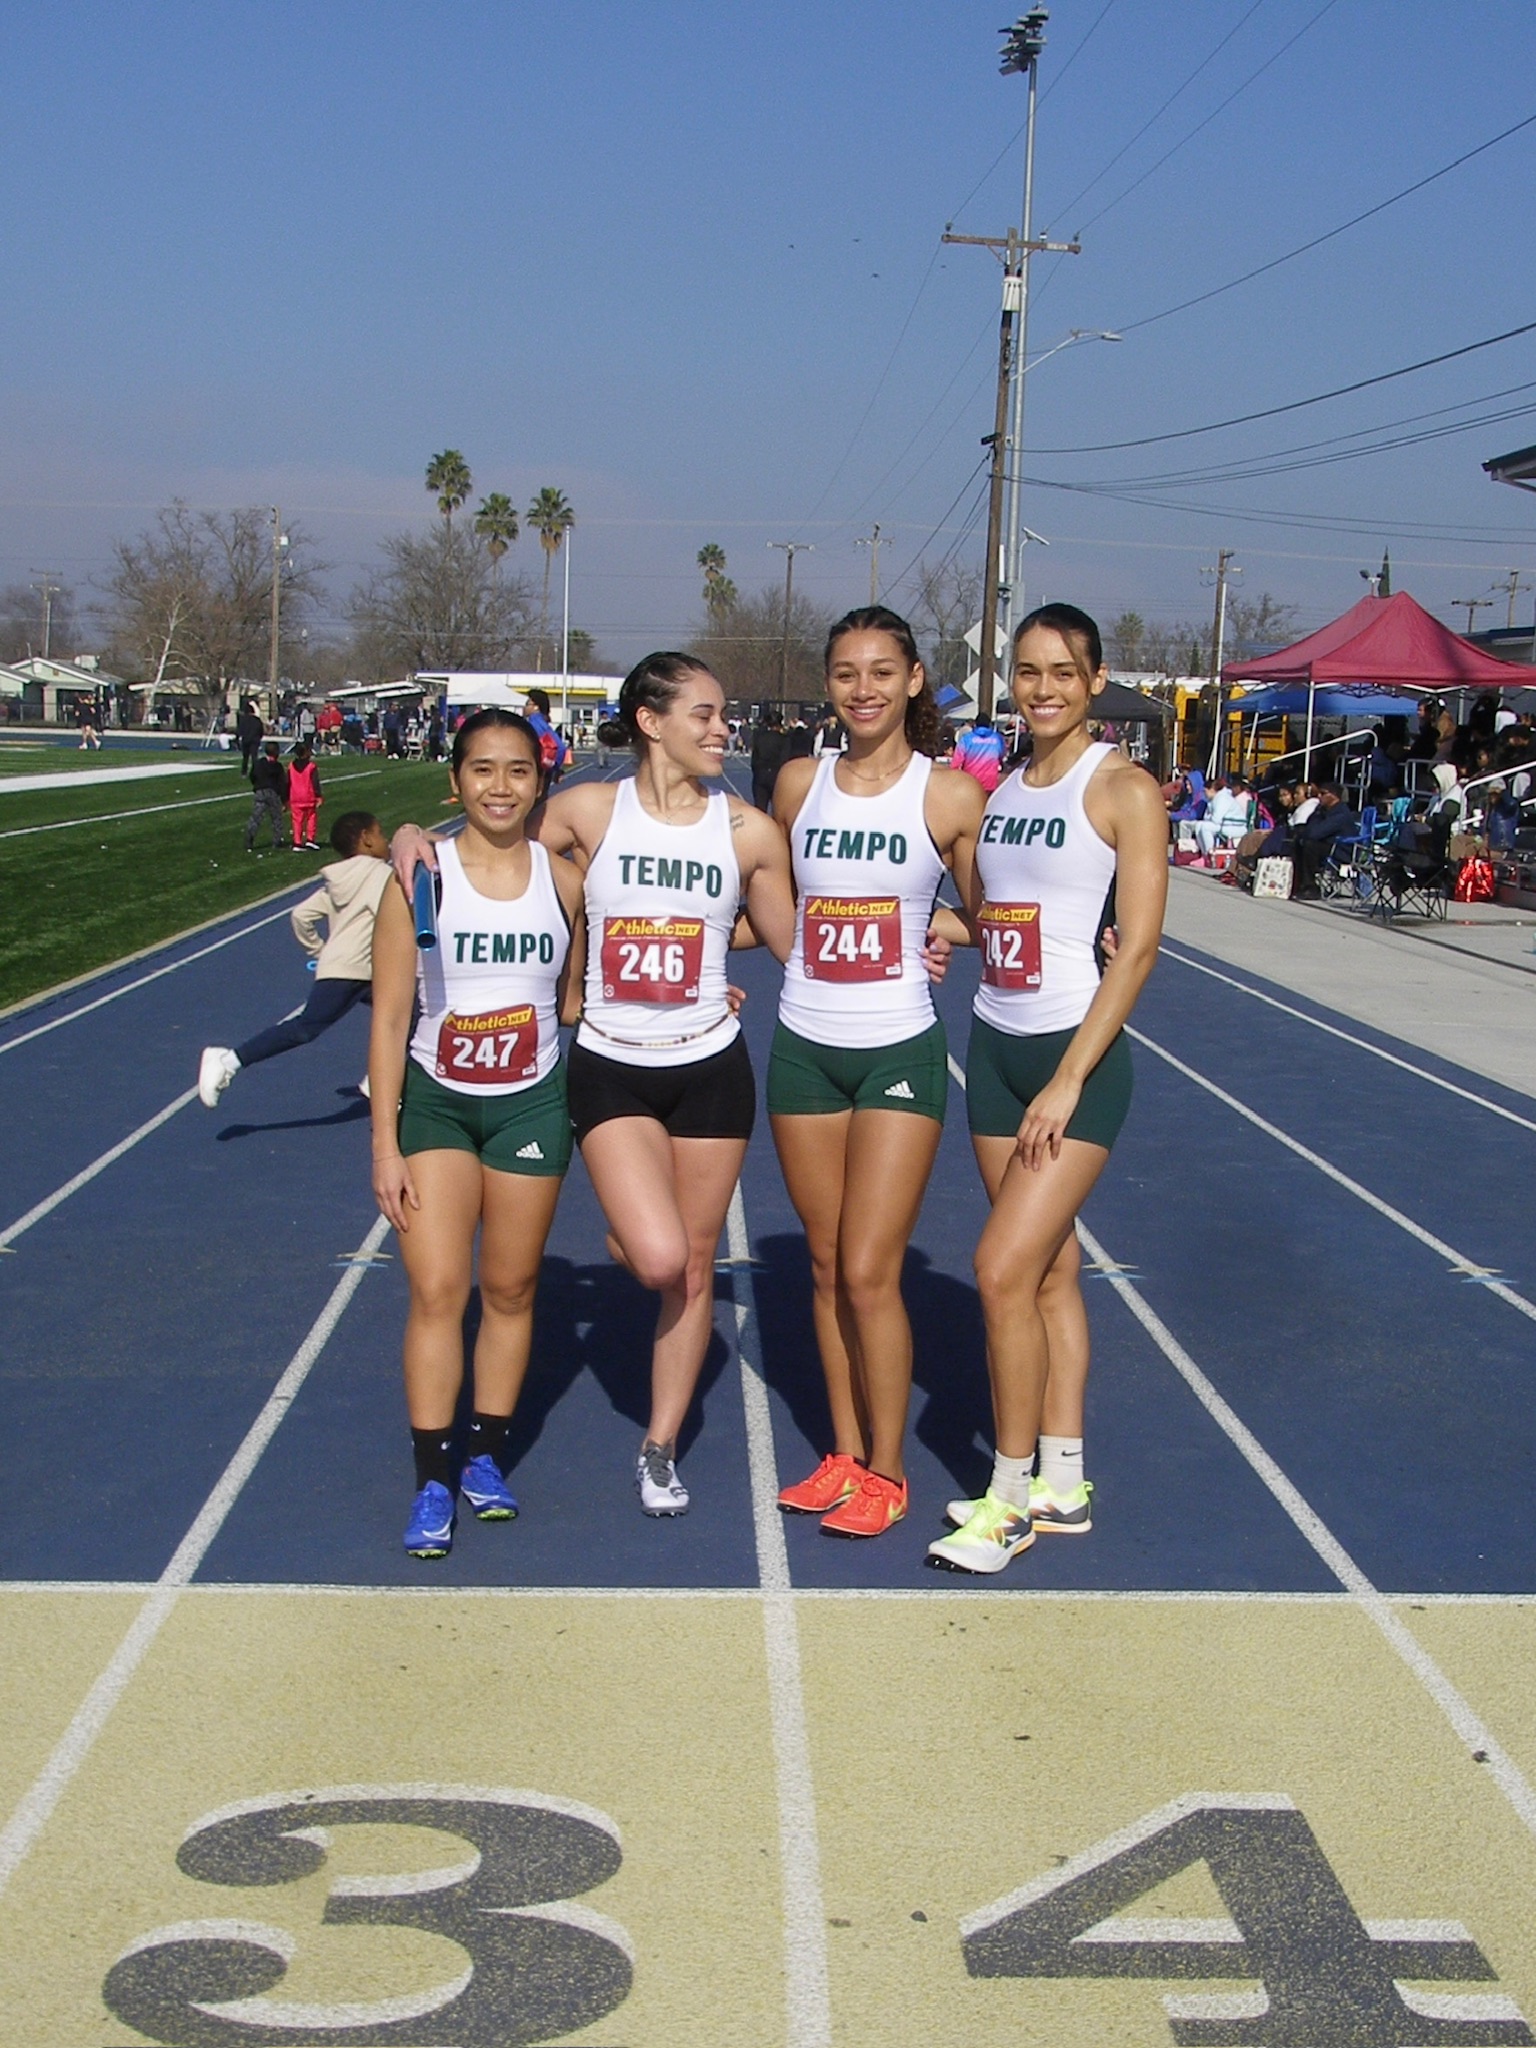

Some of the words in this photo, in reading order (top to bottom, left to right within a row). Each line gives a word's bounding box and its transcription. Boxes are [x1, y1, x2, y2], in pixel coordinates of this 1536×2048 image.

[803, 828, 907, 865] TEMPO
[618, 855, 723, 898] TEMPO
[453, 932, 554, 964] TEMPO
[618, 942, 685, 983] 246
[817, 923, 883, 962] 244
[451, 1032, 520, 1069] 247
[101, 1783, 636, 2048] 3
[958, 1791, 1536, 2048] 4
